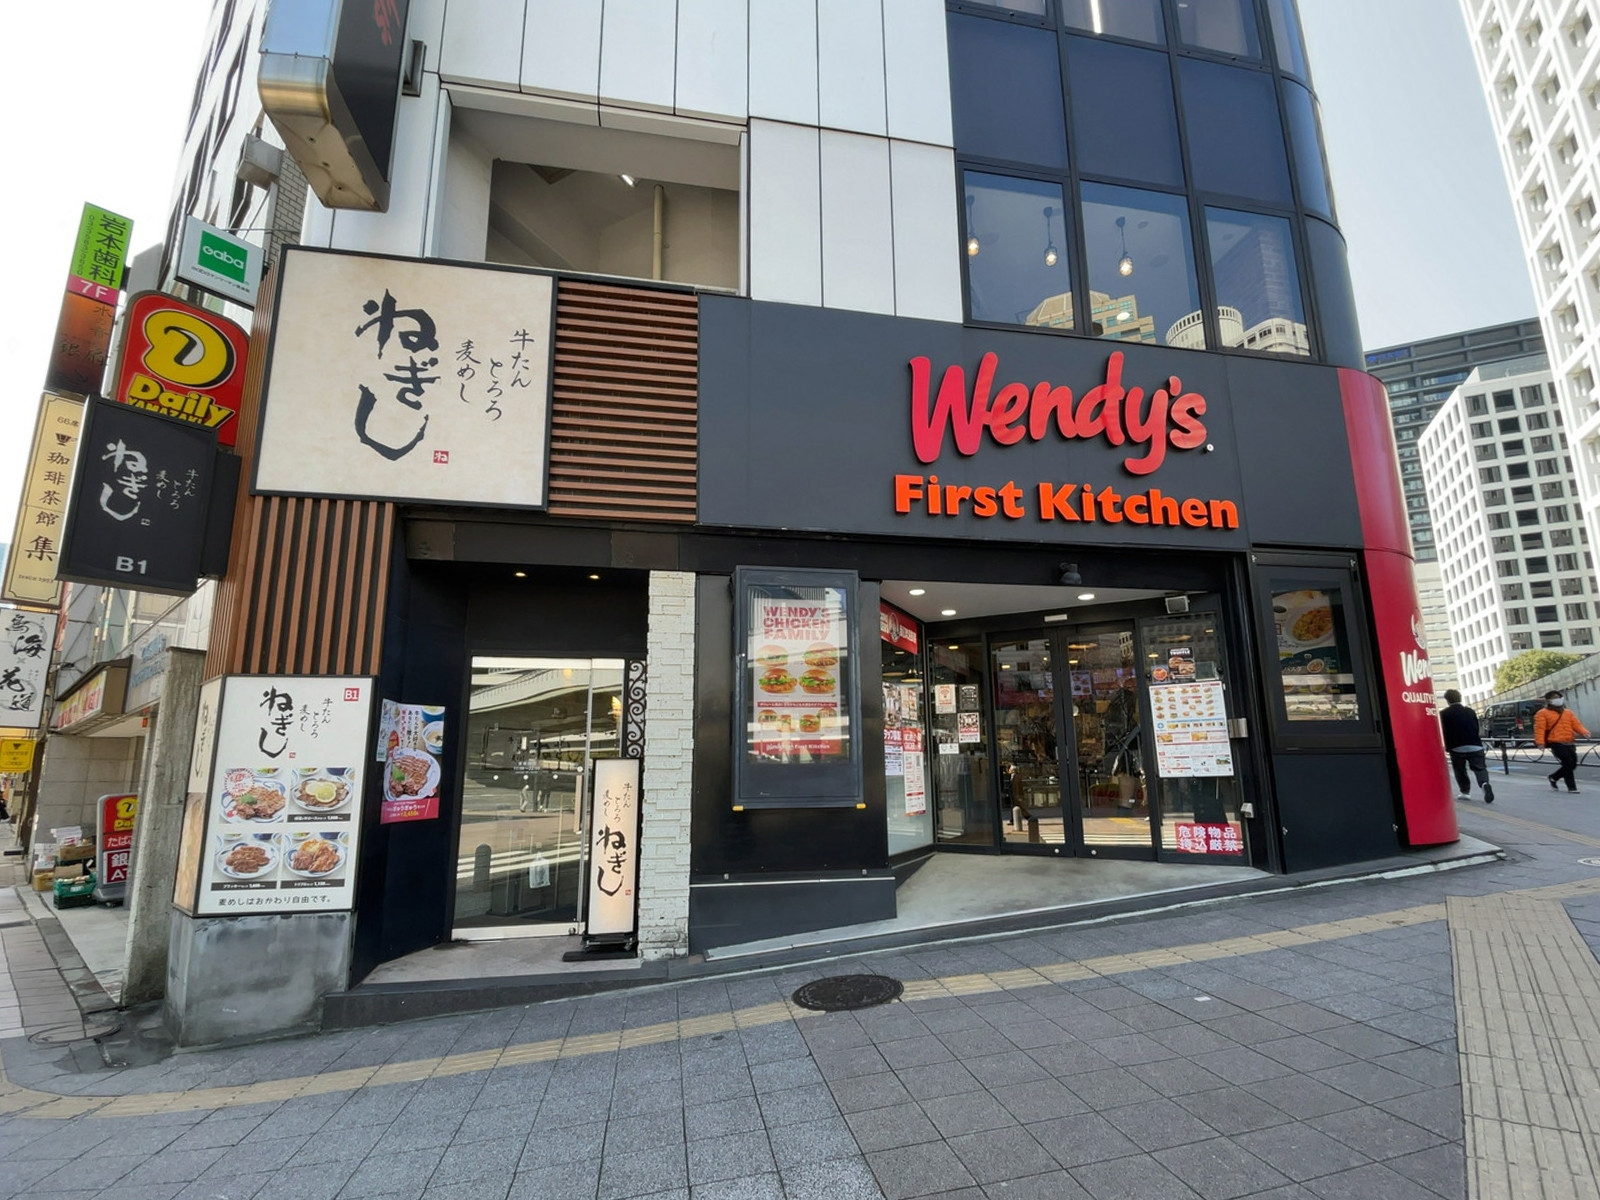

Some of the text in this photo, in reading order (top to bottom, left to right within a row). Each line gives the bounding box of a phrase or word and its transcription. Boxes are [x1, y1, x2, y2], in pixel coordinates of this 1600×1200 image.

[80, 280, 109, 299] 7F
[355, 288, 441, 461] ねぎし
[455, 339, 481, 404] 麦めし
[509, 328, 535, 389] 牛たん
[128, 373, 235, 428] Daily
[485, 357, 504, 422] とろろ
[908, 351, 1208, 476] Wendy's
[100, 438, 148, 521] ねぎし
[155, 470, 169, 499] 麦めし
[184, 468, 199, 498] 牛たん
[893, 474, 1239, 529] First Kitchen
[115, 556, 147, 575] B1
[259, 685, 294, 759] ねぎし
[321, 698, 333, 724] 牛たん
[345, 689, 358, 700] B1
[596, 824, 627, 897] ねぎし
[218, 895, 331, 906] 麦めしはおかわり自由です。
